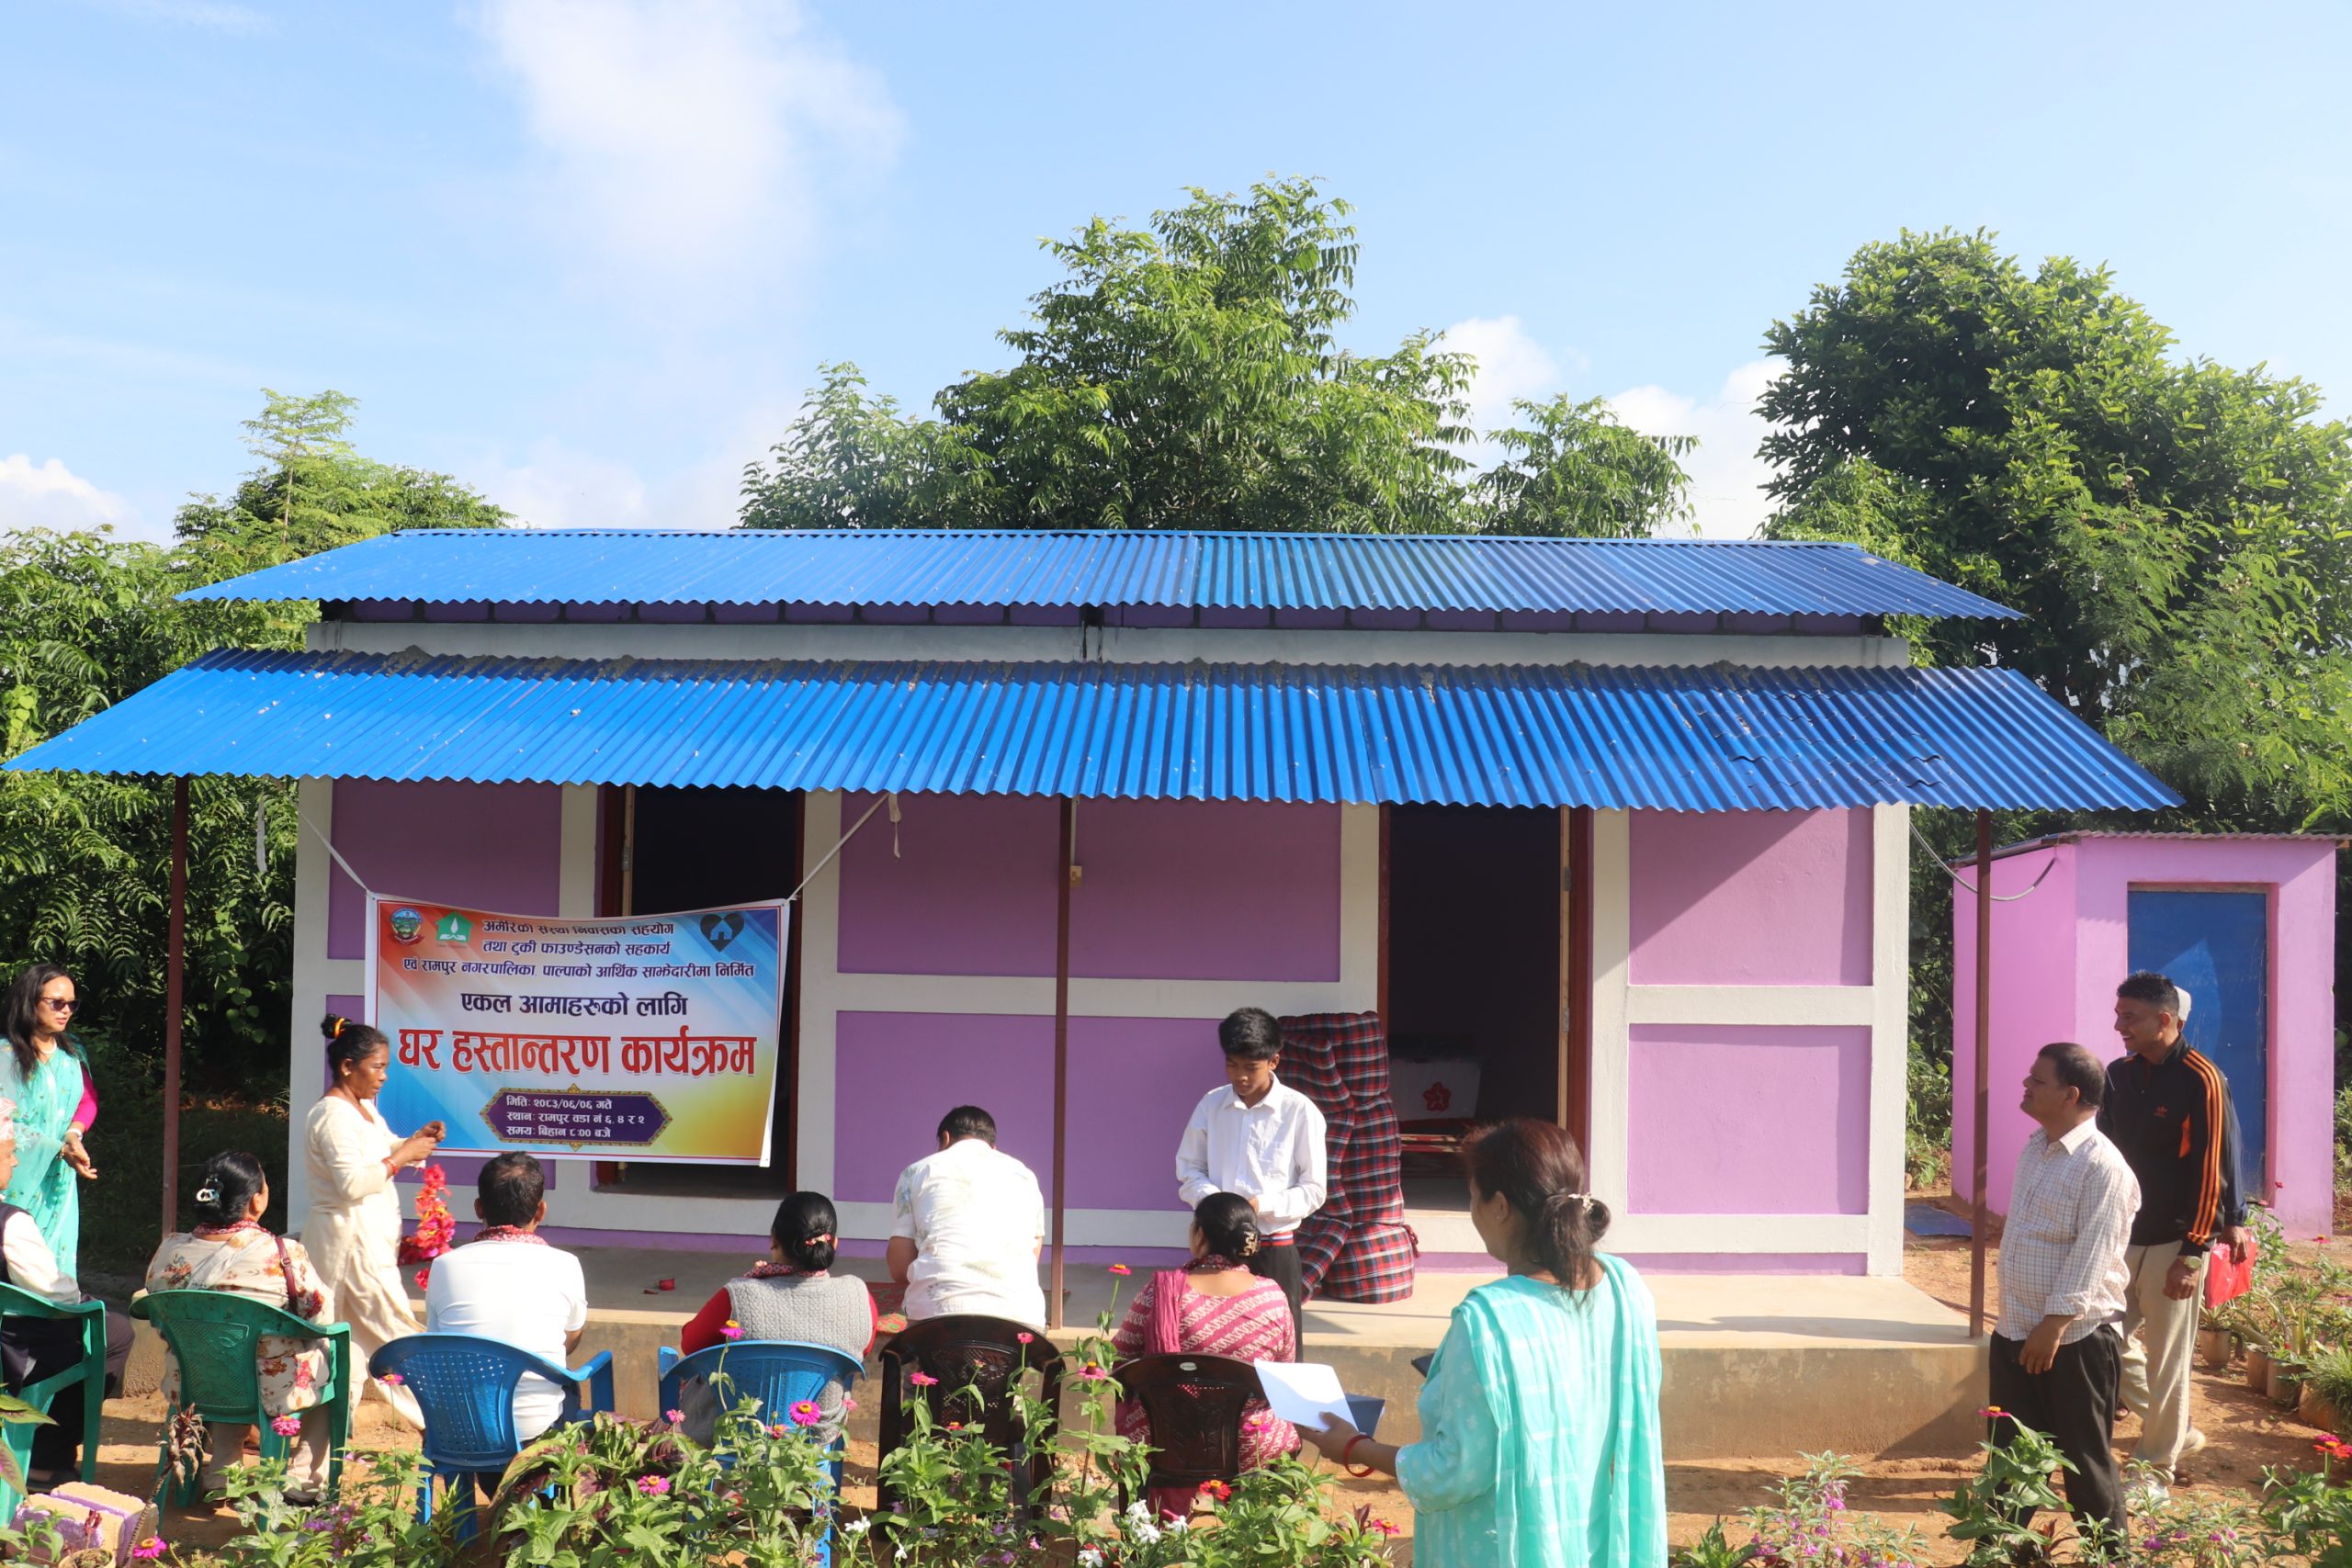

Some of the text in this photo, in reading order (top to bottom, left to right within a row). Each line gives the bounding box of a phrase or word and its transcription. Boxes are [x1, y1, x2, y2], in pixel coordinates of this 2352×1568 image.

[631, 922, 675, 936] सहयोग
[482, 940, 506, 953] तथा
[540, 941, 620, 955] फाउण्डेसनको
[624, 941, 671, 955] सहकार्य
[403, 956, 418, 970] एवं
[422, 959, 458, 976] रामपुर
[542, 963, 592, 977] पाल्पाको
[596, 963, 638, 978] आर्थिक
[642, 963, 711, 978] साझेदारीमा
[715, 961, 755, 978] निर्मित
[460, 992, 513, 1013] एकल
[636, 992, 689, 1016] लागि
[398, 1025, 757, 1077] घर हस्तान्तरण कार्यक्रम
[506, 1095, 531, 1107] मिति:
[596, 1099, 613, 1110] गते
[506, 1111, 536, 1122] स्थान:
[538, 1112, 571, 1124] रामपुर
[572, 1114, 591, 1123] वडा
[617, 1115, 625, 1124] ४
[628, 1115, 636, 1124] र
[638, 1115, 645, 1124] २
[506, 1125, 536, 1136] समय:
[538, 1125, 566, 1137] बिहान
[594, 1128, 611, 1138] बजे
